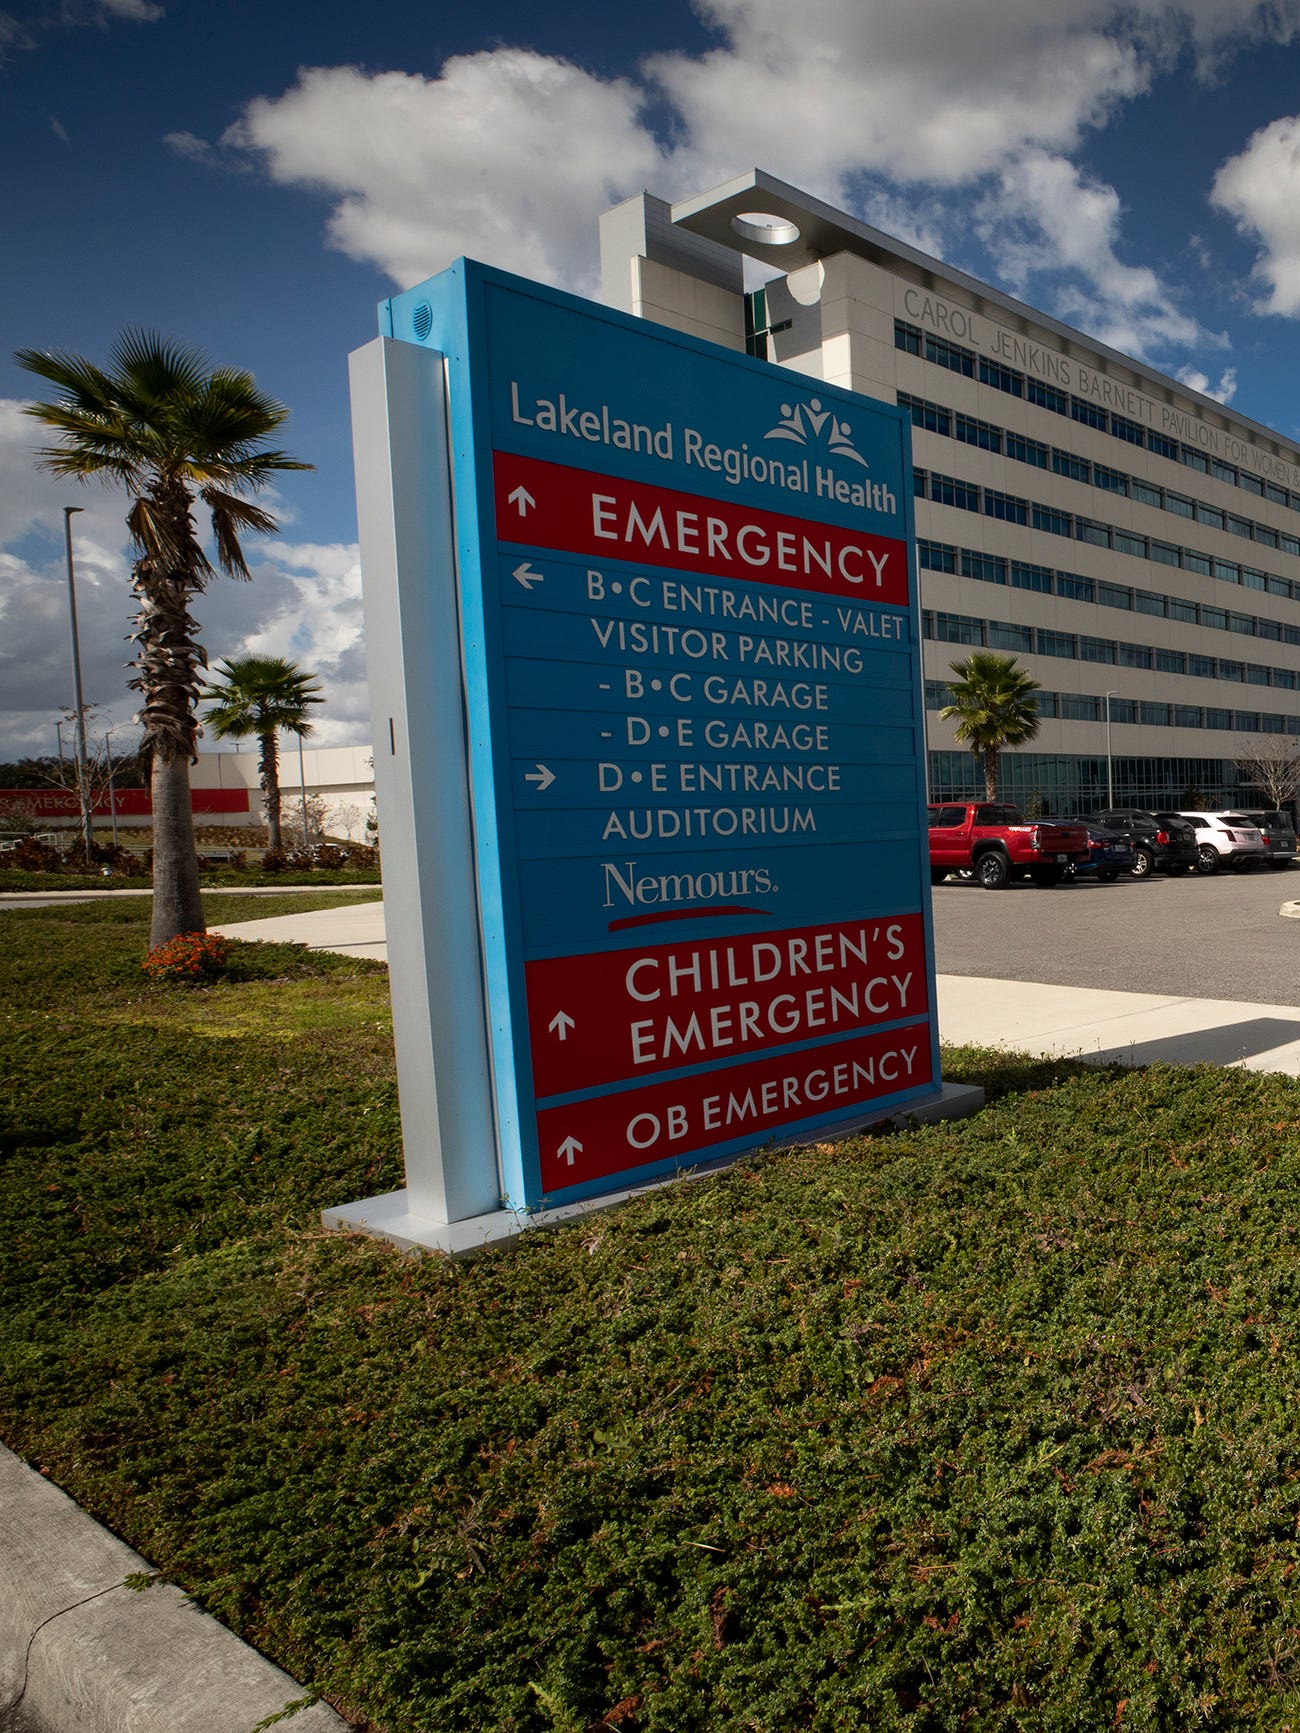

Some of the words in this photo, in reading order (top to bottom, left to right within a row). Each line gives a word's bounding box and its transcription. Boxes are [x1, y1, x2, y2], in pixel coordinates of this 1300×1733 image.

[904, 289, 980, 346] CAROL
[990, 330, 1071, 385] JENKINS
[1079, 368, 1155, 422] BARNETT
[1162, 407, 1218, 451] PAVILION
[1225, 437, 1248, 465] FOR
[1252, 450, 1290, 484] WOMEN
[1293, 469, 1300, 488] &
[511, 381, 673, 460] Lakeland
[684, 428, 809, 493] Regional
[815, 466, 897, 515] Health
[592, 493, 889, 587] EMERGENCY
[662, 581, 813, 628] ENTRANCE
[837, 607, 903, 640] VALET
[591, 618, 729, 660] VISITOR
[739, 635, 863, 673] PARKING
[703, 676, 828, 710] GARAGE
[704, 720, 829, 751] GARAGE
[680, 764, 841, 791] ENTRANCE
[602, 807, 816, 840] AUDITORIUM
[625, 924, 905, 1002] CHILDREN'S
[630, 972, 913, 1065] EMERGENCY
[626, 1105, 689, 1149] OB
[703, 1045, 917, 1130] EMERGENCY
